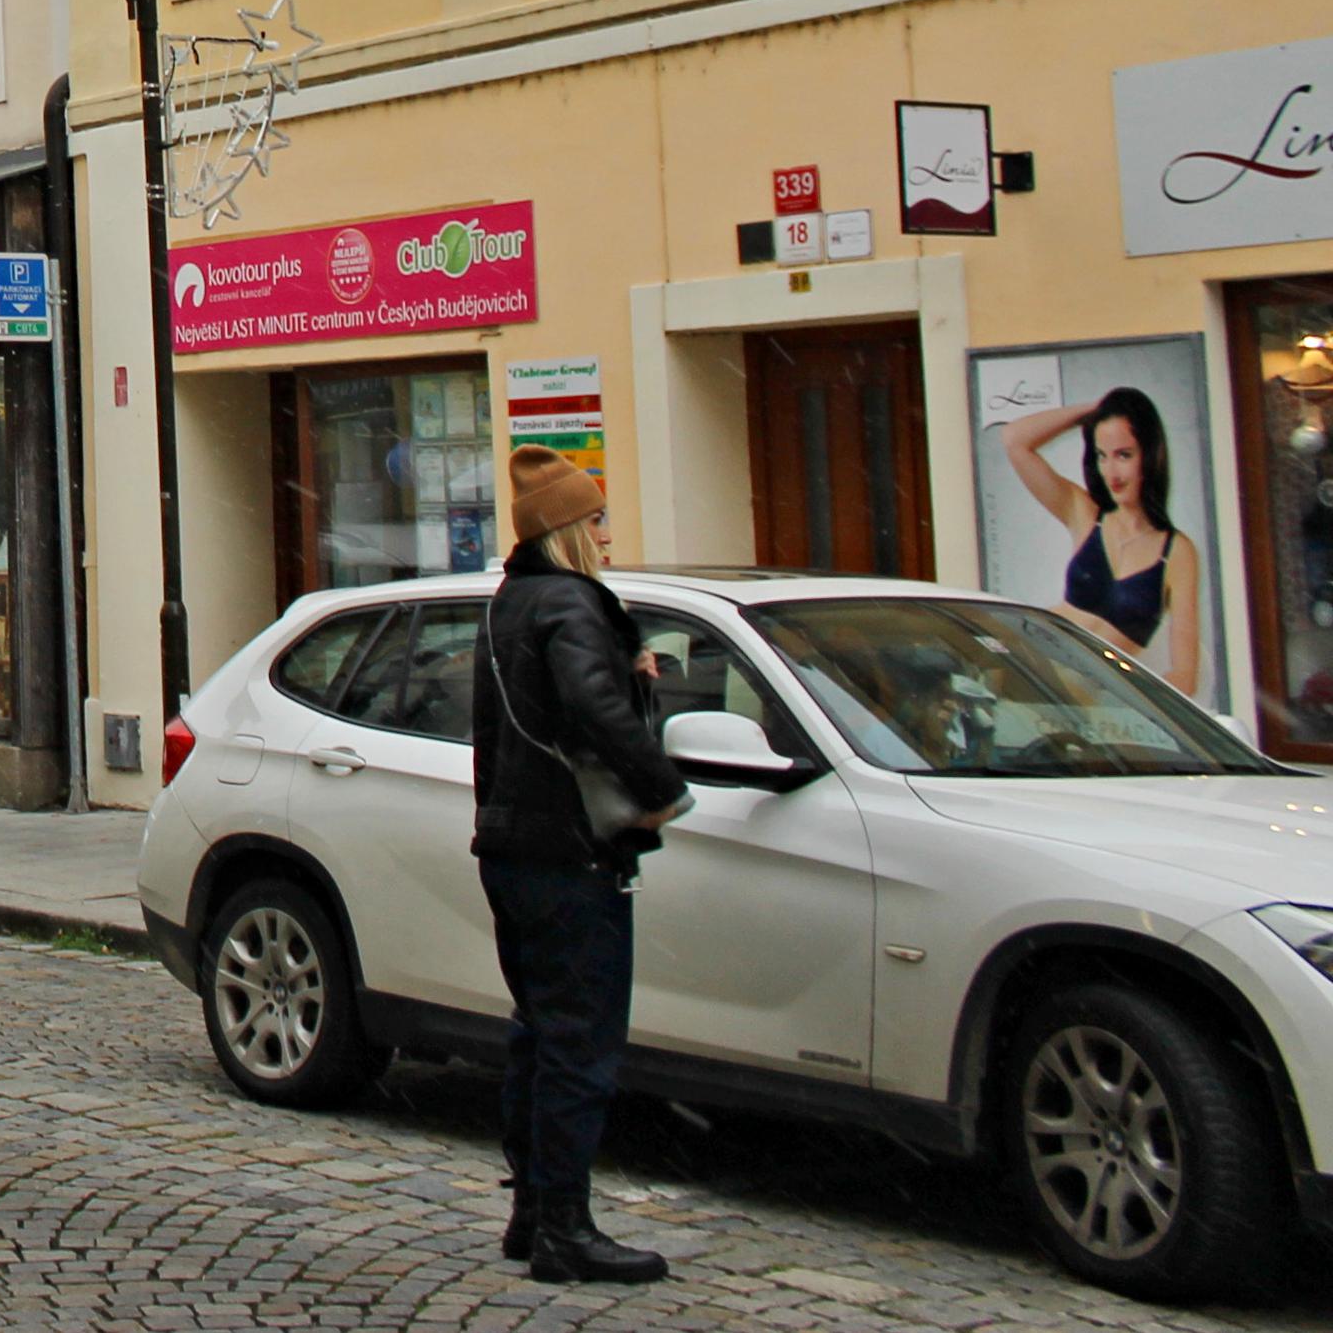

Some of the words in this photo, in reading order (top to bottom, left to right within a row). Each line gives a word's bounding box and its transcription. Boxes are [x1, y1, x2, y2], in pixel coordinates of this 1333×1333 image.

[776, 172, 814, 199] 339
[787, 221, 808, 245] 18
[397, 234, 449, 275] Club
[469, 229, 527, 265] Tour
[208, 261, 270, 286] kovotour
[272, 254, 302, 285] plus
[2, 293, 39, 302] AUTOMAT
[209, 289, 239, 303] cestovní
[176, 322, 221, 348] Největší
[224, 317, 254, 340] LAST
[258, 312, 308, 336] MINUTE
[312, 309, 364, 331] centrum
[366, 312, 375, 325] v
[378, 299, 434, 327] Českých
[438, 289, 528, 321] Budějovicích
